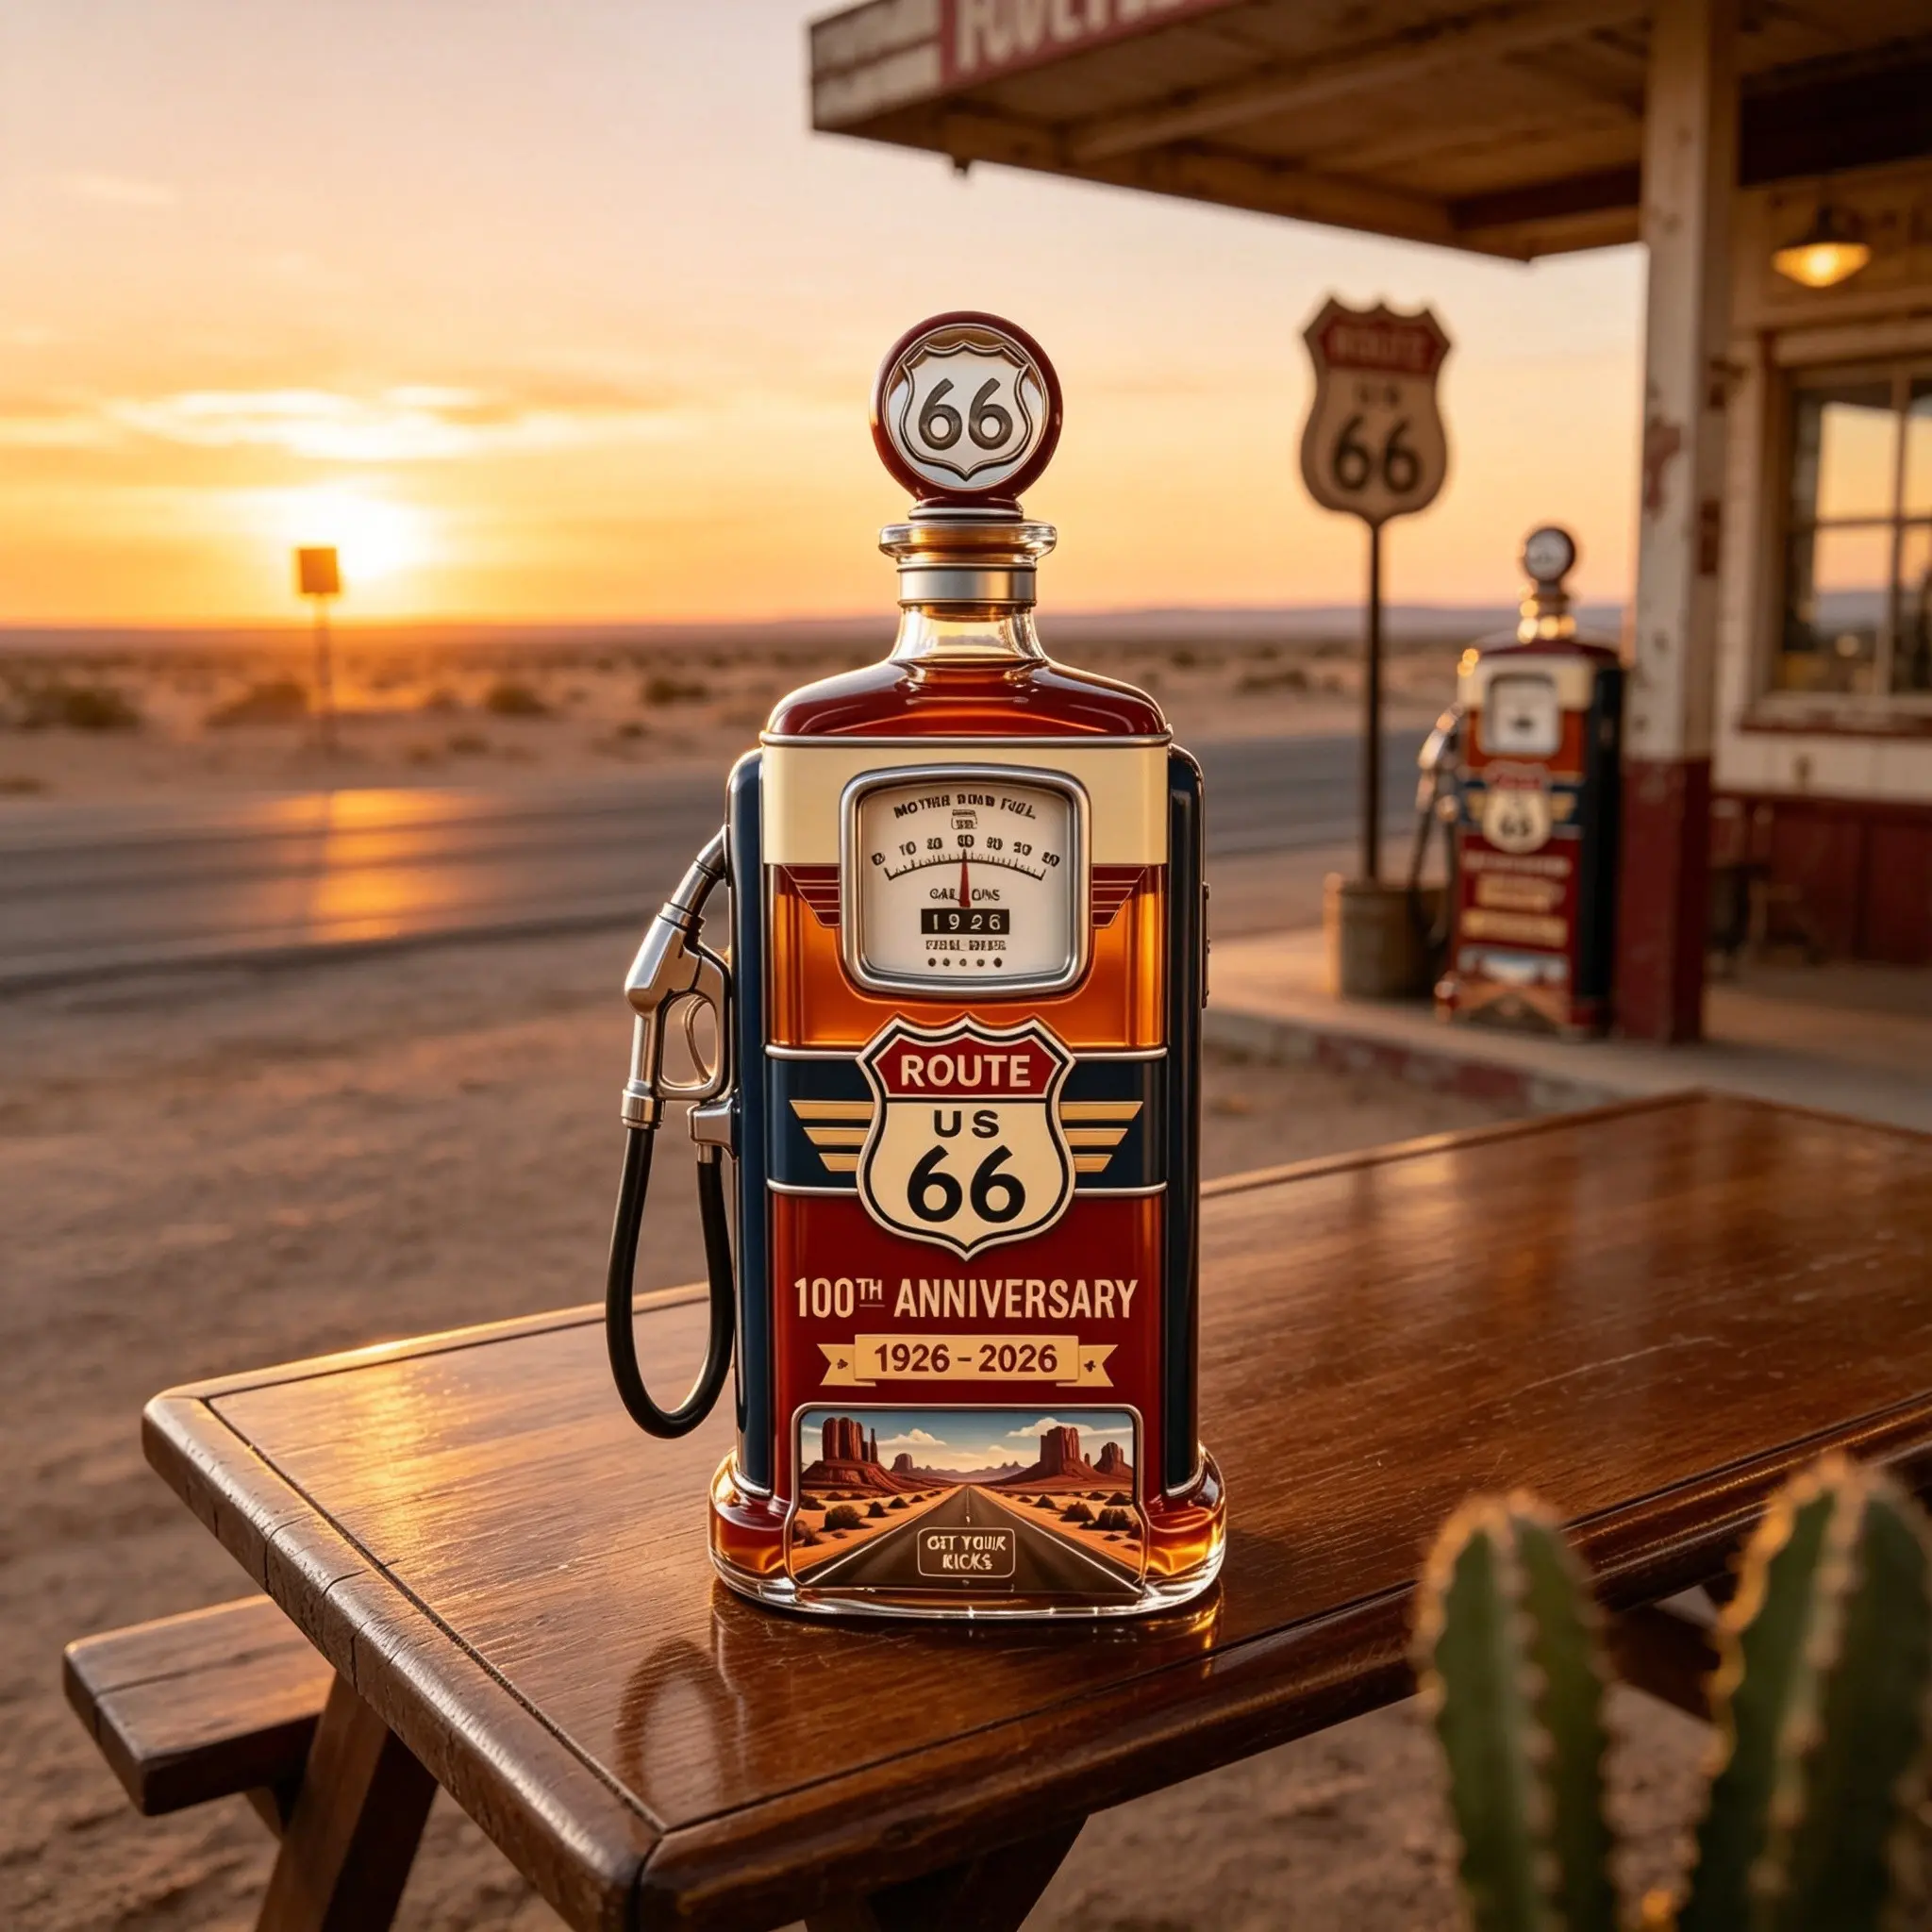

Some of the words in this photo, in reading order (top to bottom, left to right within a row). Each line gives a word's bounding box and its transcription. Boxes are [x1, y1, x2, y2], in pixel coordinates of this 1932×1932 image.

[918, 377, 1013, 451] 66
[1333, 416, 1420, 494] 66
[933, 913, 1001, 931] 1926
[901, 1054, 1031, 1088] ROUTE
[933, 1109, 1000, 1139] US
[907, 1144, 1026, 1224] 66
[793, 1277, 885, 1319] 100TH
[893, 1278, 1139, 1319] ANNIVERSARY
